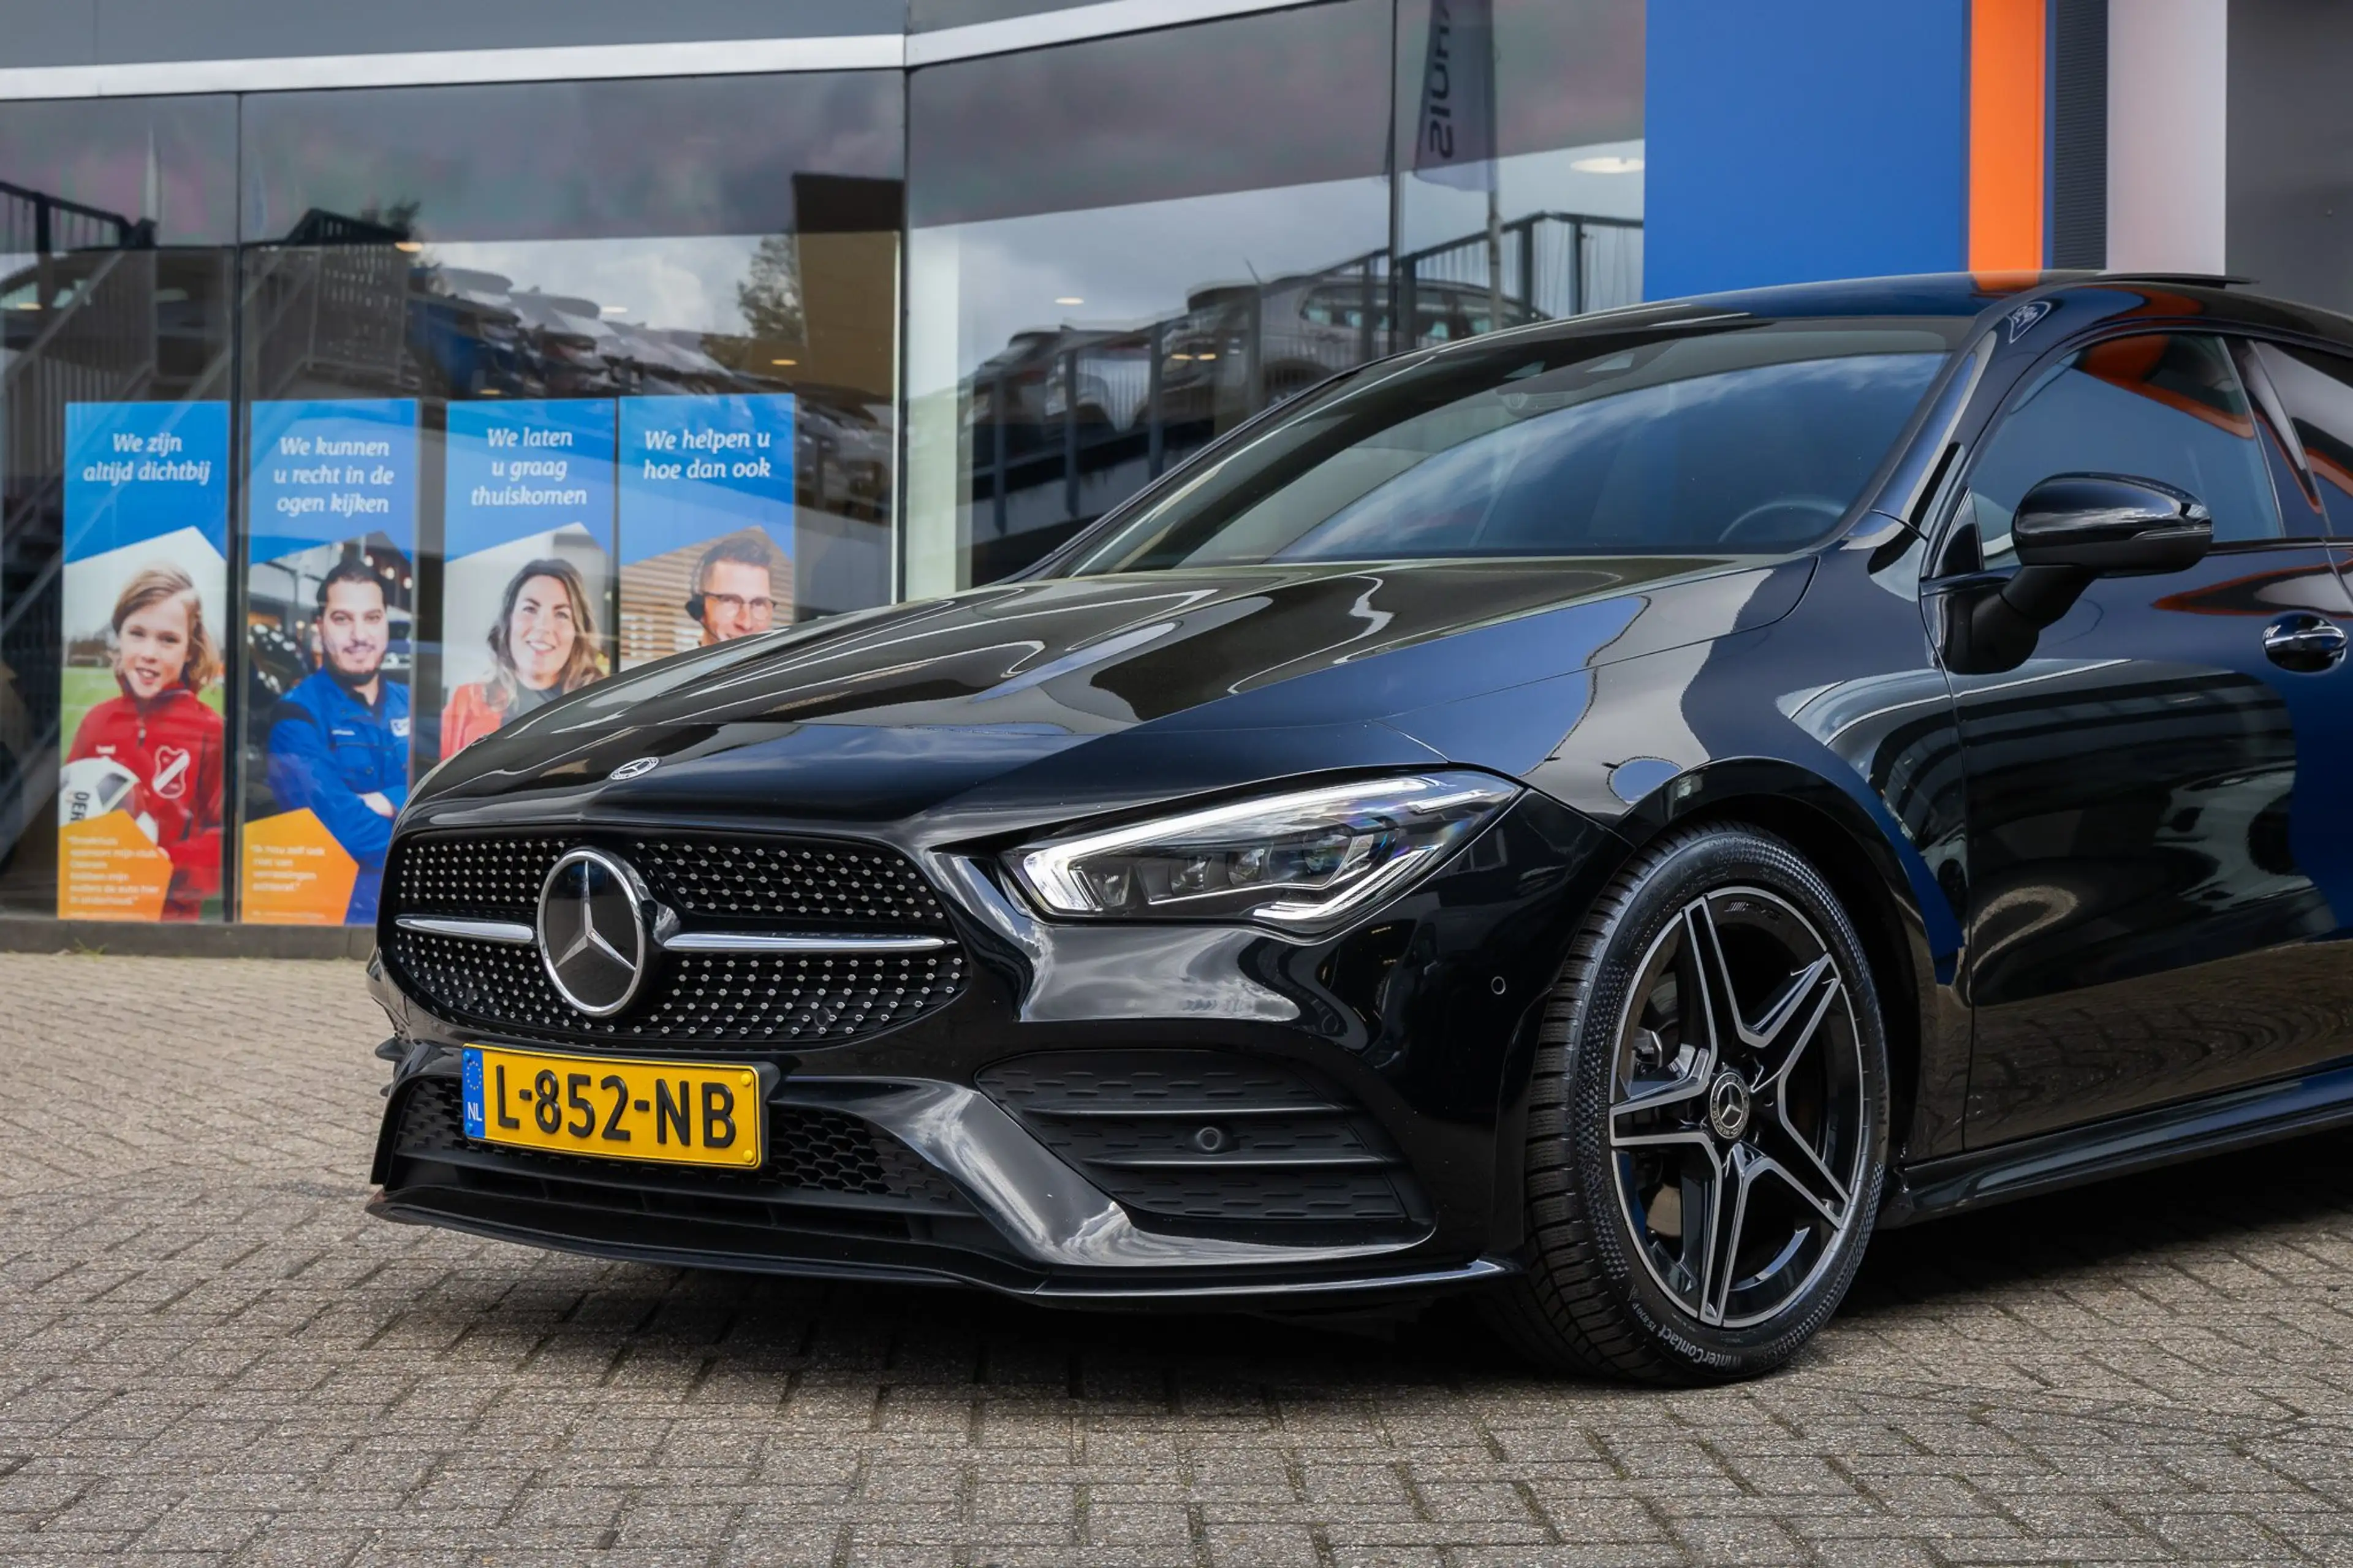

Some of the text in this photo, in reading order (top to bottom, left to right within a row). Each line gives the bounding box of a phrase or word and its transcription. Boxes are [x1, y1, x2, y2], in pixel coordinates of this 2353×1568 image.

[113, 432, 182, 456] We zijn
[280, 436, 389, 456] We kunnen
[487, 426, 573, 447] We laten
[645, 428, 770, 453] We helpen u
[83, 461, 211, 485] altijd dichtbij
[274, 464, 394, 484] u recht in de
[492, 461, 567, 481] u graag
[643, 457, 770, 479] hoe dan ook
[276, 493, 388, 517] ogen kijken
[472, 486, 586, 505] thuiskomen
[468, 1102, 483, 1121] NL
[496, 1065, 737, 1148] L-852-NB
